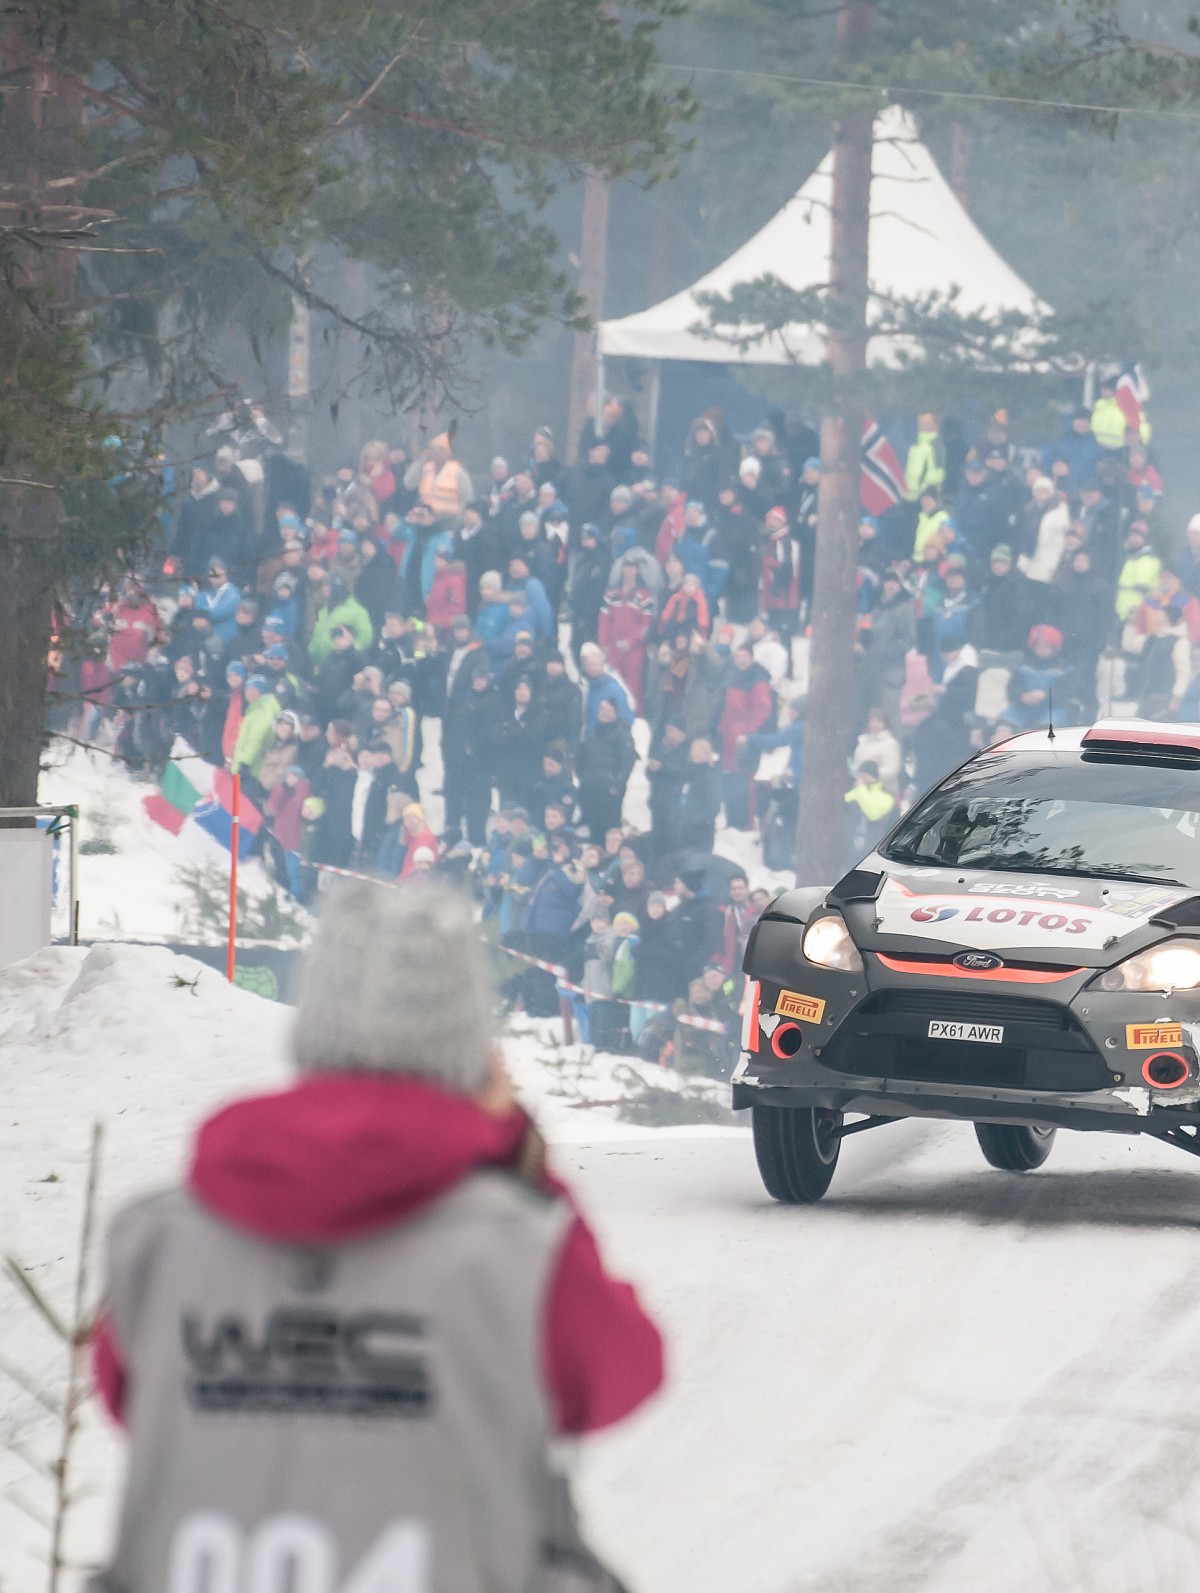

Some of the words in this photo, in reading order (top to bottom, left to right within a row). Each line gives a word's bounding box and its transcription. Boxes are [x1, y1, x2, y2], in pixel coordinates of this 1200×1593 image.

[964, 906, 1093, 935] LOTOS
[962, 954, 992, 968] Ford
[780, 994, 819, 1018] PIRELLI
[931, 1023, 964, 1038] PX61
[967, 1026, 1001, 1041] AWR
